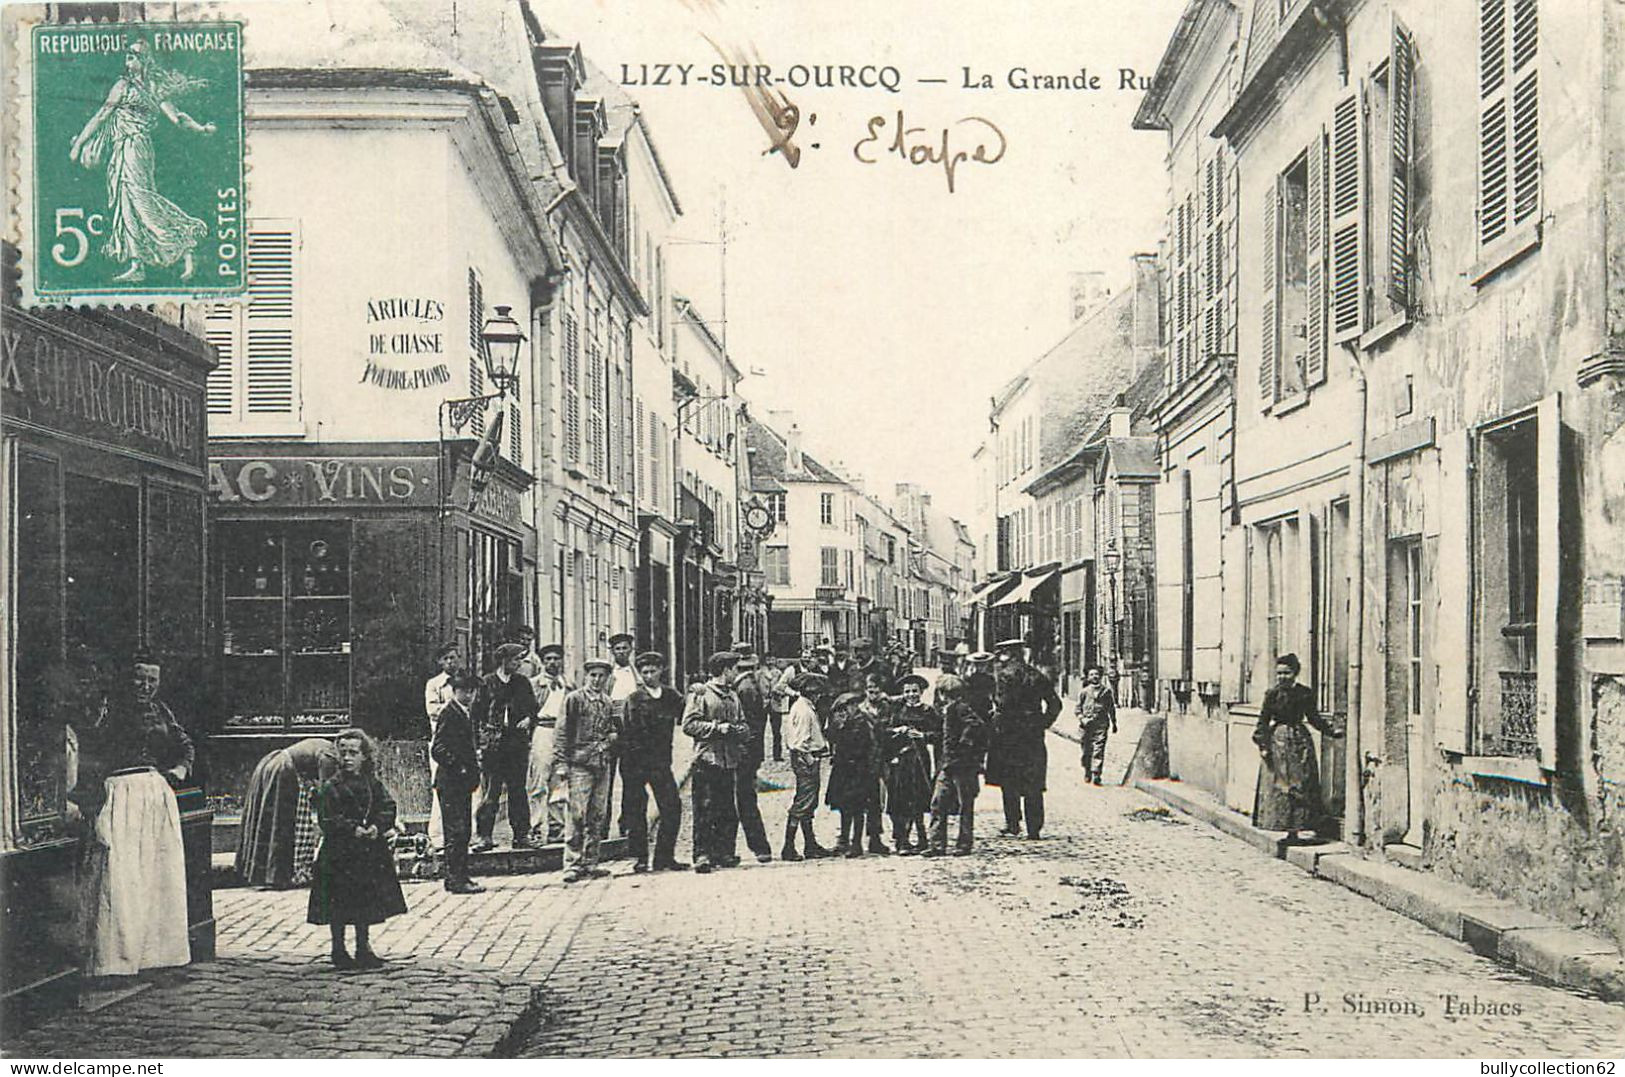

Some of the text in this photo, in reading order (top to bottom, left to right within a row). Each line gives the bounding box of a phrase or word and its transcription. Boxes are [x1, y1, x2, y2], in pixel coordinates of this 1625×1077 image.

[154, 32, 235, 54] FRANÇAISE
[218, 187, 238, 276] POSTES
[367, 297, 445, 324] ARTICLES
[370, 333, 444, 354] DE CHASSE
[305, 460, 416, 501] VINS
